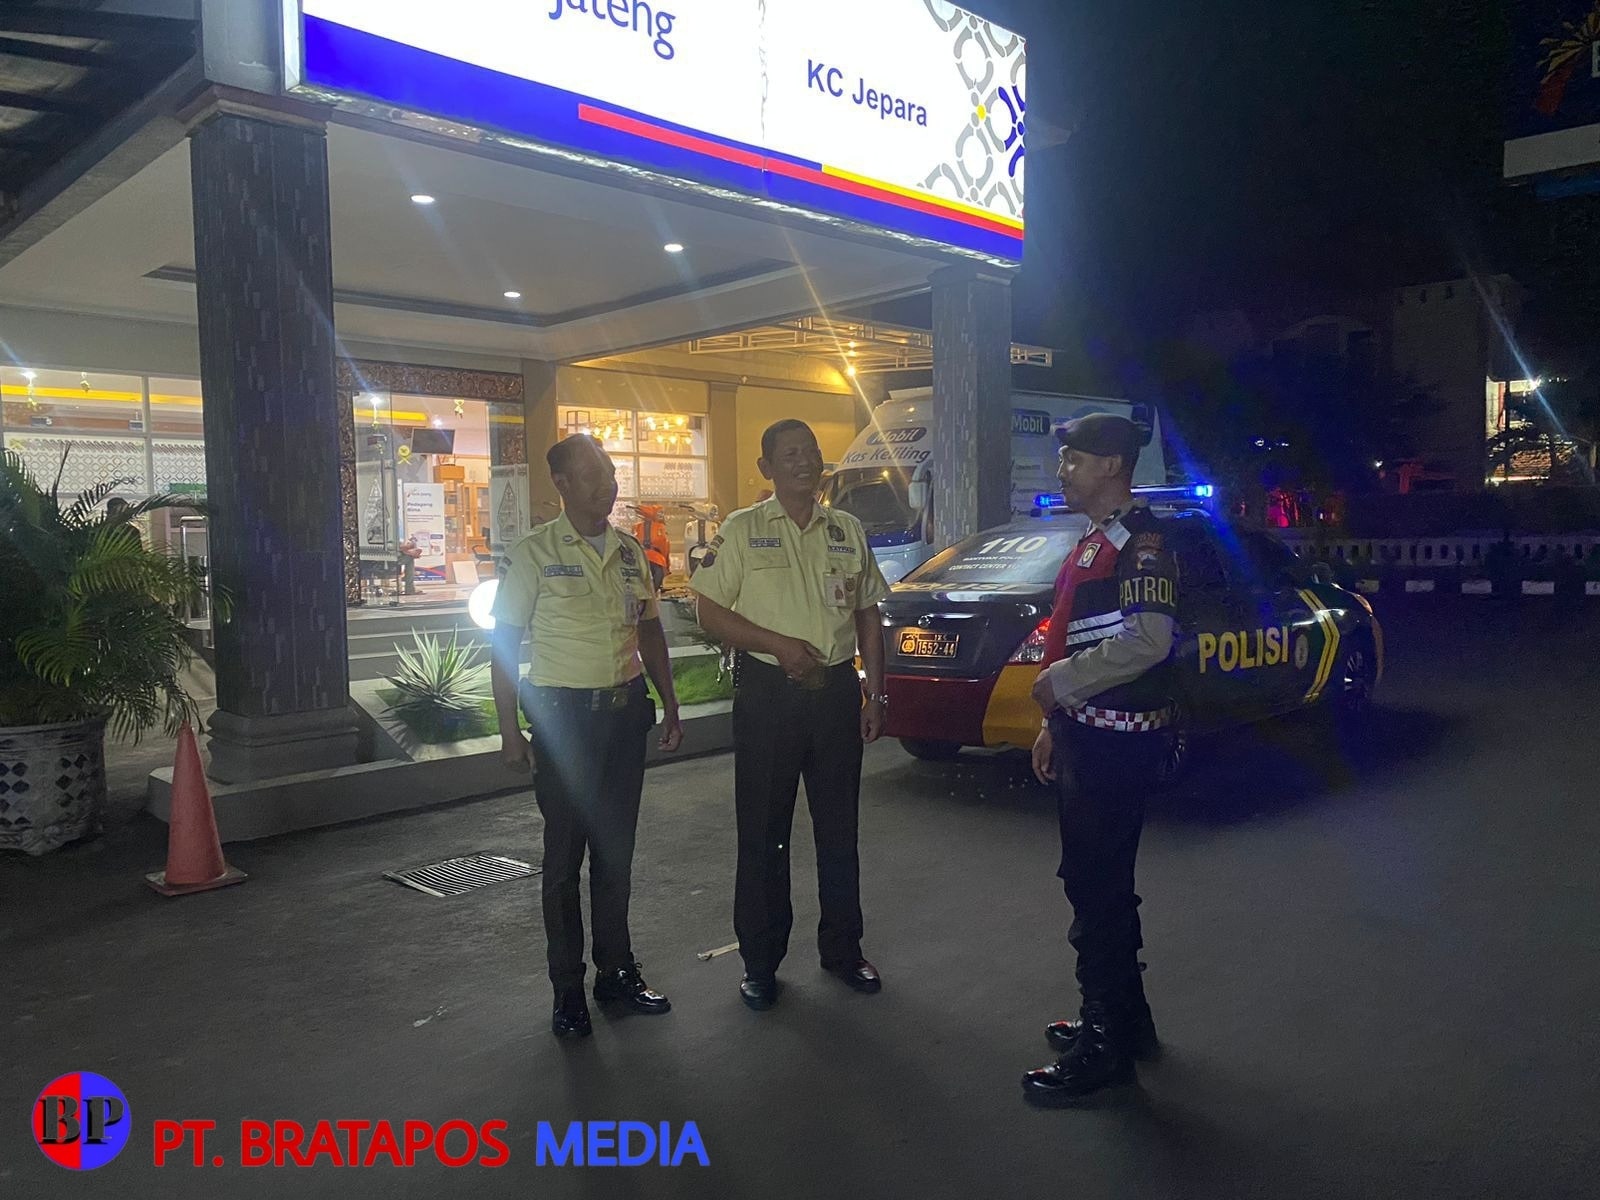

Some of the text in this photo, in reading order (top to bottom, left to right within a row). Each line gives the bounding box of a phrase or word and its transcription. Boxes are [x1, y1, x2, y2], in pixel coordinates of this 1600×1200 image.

[808, 59, 927, 127] KC Jepara
[1011, 414, 1044, 432] Mobil
[871, 428, 919, 444] Mobil
[842, 446, 931, 464] Kas Keliling
[979, 536, 1047, 555] 110
[948, 563, 980, 571] CONTACT
[1120, 576, 1175, 608] PATROL
[918, 641, 955, 655] 1552-44
[1198, 626, 1289, 674] POLISI
